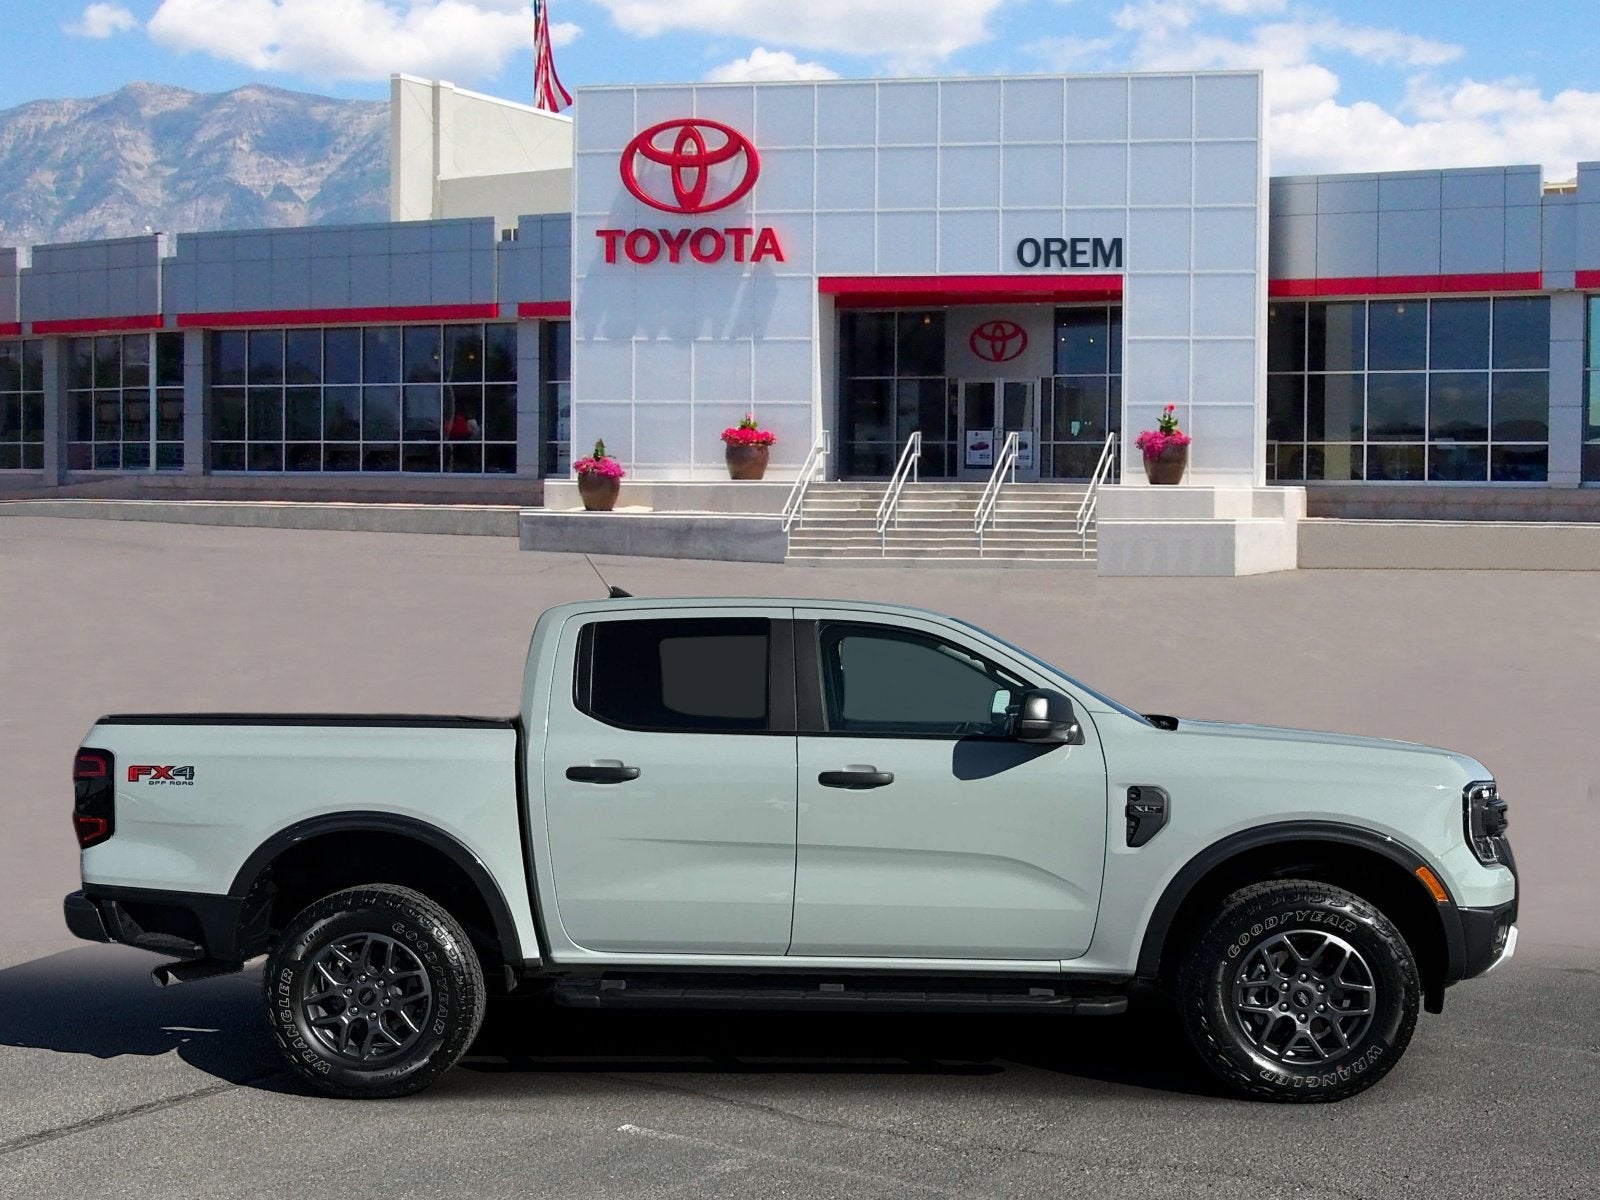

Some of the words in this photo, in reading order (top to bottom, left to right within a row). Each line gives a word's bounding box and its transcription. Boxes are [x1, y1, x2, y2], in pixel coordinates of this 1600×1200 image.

[596, 227, 784, 264] TOYOTA
[1017, 237, 1123, 268] OREM
[128, 765, 195, 782] FX4
[1228, 910, 1358, 958] GOODYEAR
[392, 922, 449, 1035] GOODYEAR
[278, 967, 332, 1075] WRANGLER
[1260, 1045, 1383, 1088] WRANGLER
